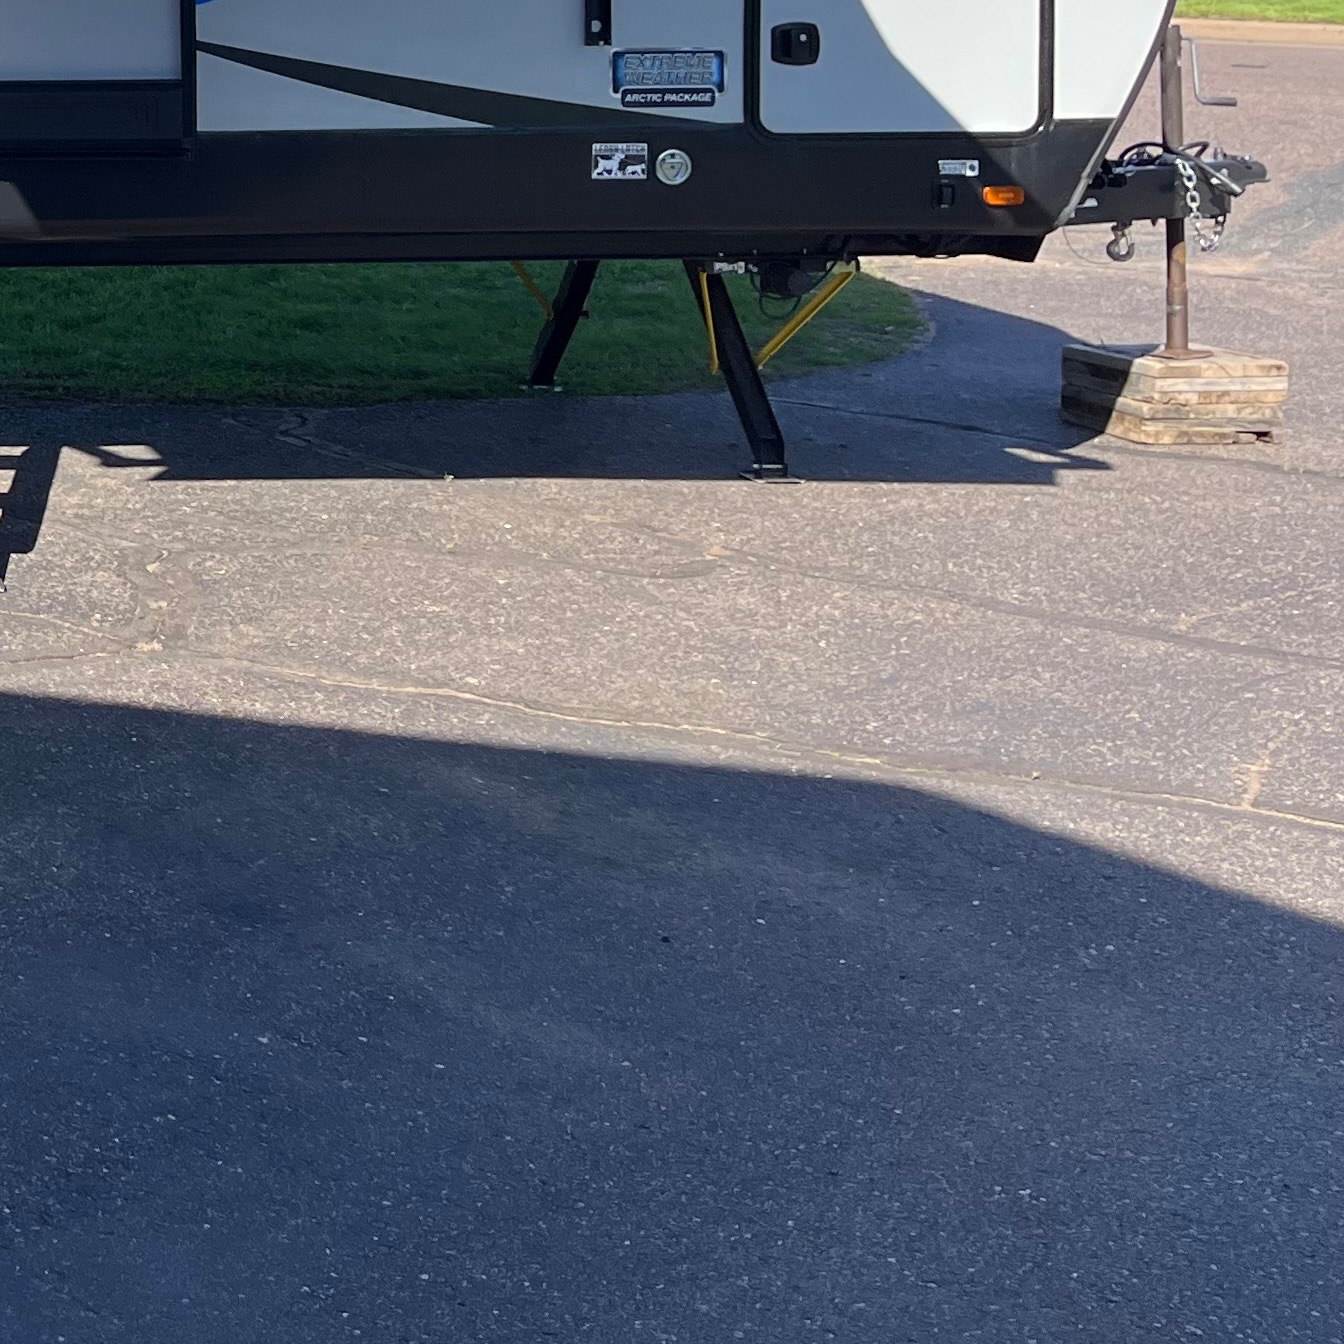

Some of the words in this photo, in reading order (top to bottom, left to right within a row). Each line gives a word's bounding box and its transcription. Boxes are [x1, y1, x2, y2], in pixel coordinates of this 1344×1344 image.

[623, 53, 715, 69] EXTREME
[623, 69, 713, 86] WEATHER
[624, 93, 663, 103] ARCTIC
[664, 92, 713, 103] PACKAGE
